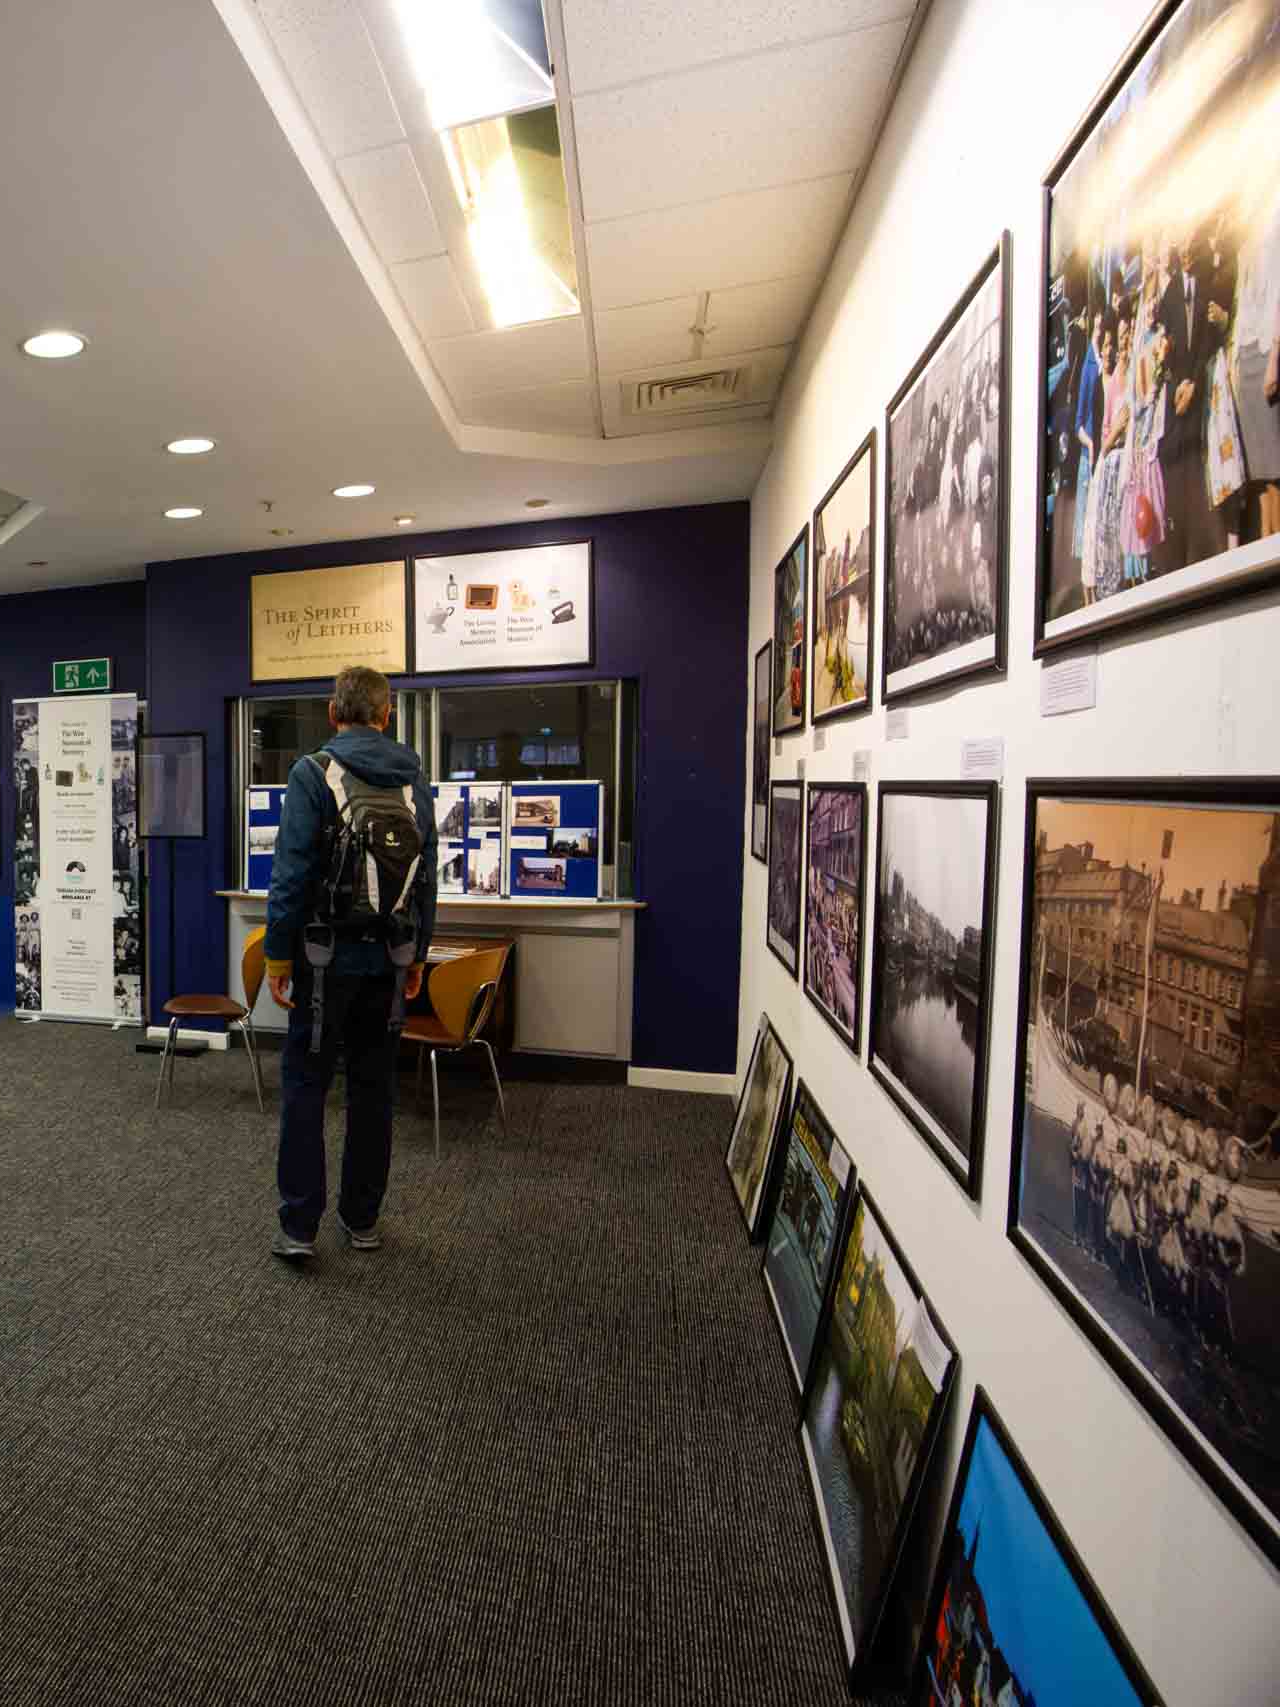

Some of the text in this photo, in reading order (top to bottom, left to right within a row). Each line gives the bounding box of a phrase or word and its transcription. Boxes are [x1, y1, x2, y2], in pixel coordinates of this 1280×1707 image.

[263, 605, 361, 625] THE SPIRIT
[287, 620, 393, 646] of LEITHERS
